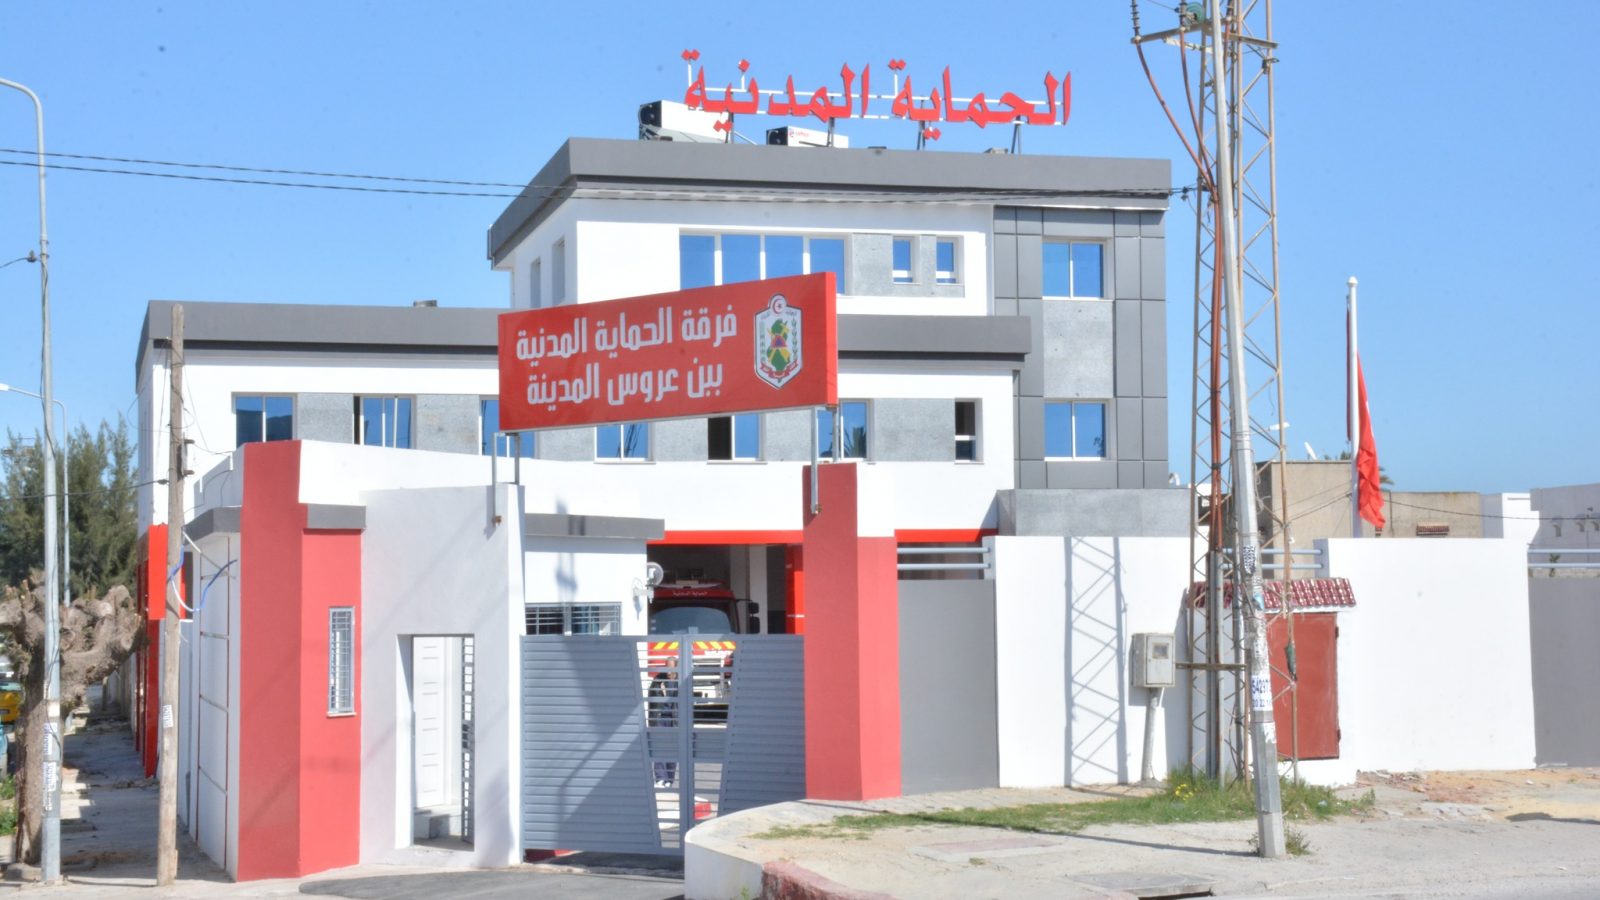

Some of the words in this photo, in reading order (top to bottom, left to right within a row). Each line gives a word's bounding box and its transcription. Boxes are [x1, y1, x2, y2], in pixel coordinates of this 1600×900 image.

[682, 50, 870, 133] المدنية
[889, 61, 1071, 139] الحماية
[516, 317, 588, 367] المدنية
[595, 306, 673, 359] الحماية
[681, 304, 737, 348] فرقة
[527, 362, 600, 411] المدينة
[607, 369, 679, 406] عروس
